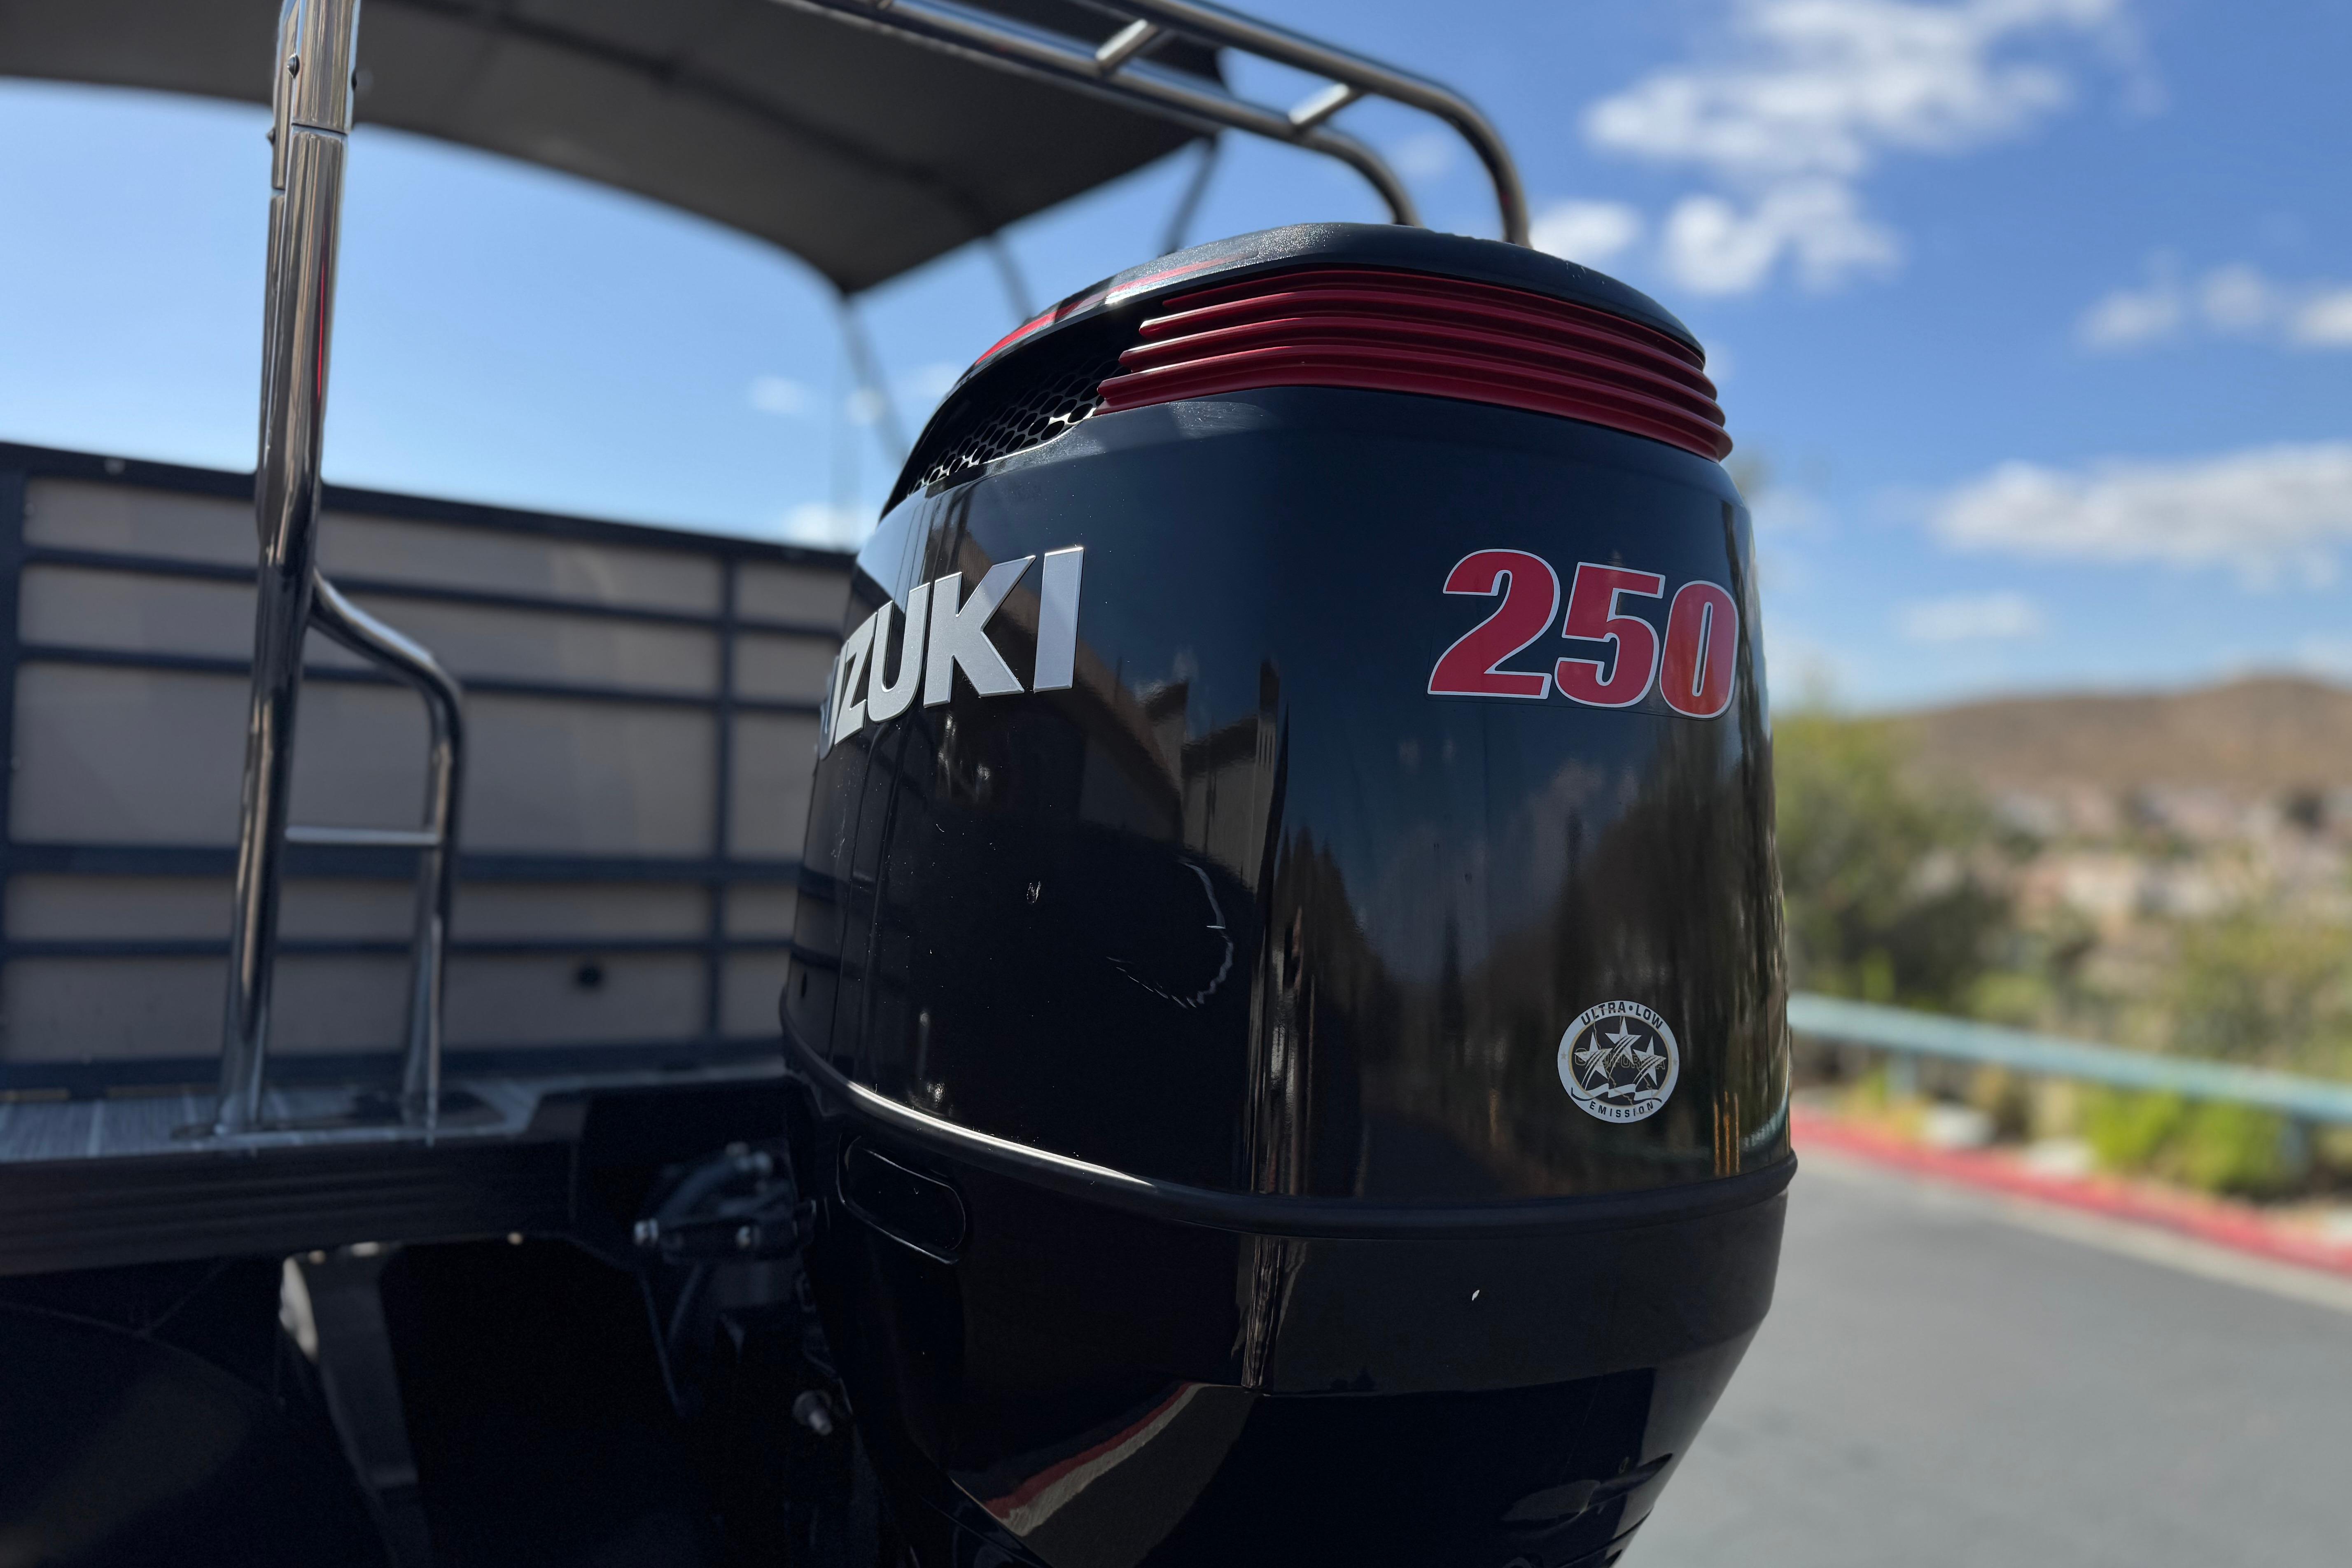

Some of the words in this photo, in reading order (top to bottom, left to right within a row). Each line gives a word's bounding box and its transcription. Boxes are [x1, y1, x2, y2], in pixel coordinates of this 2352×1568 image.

[817, 546, 1084, 761] UZUKI
[1427, 548, 1739, 719] 250
[1589, 1101, 1654, 1118] EMISSION
